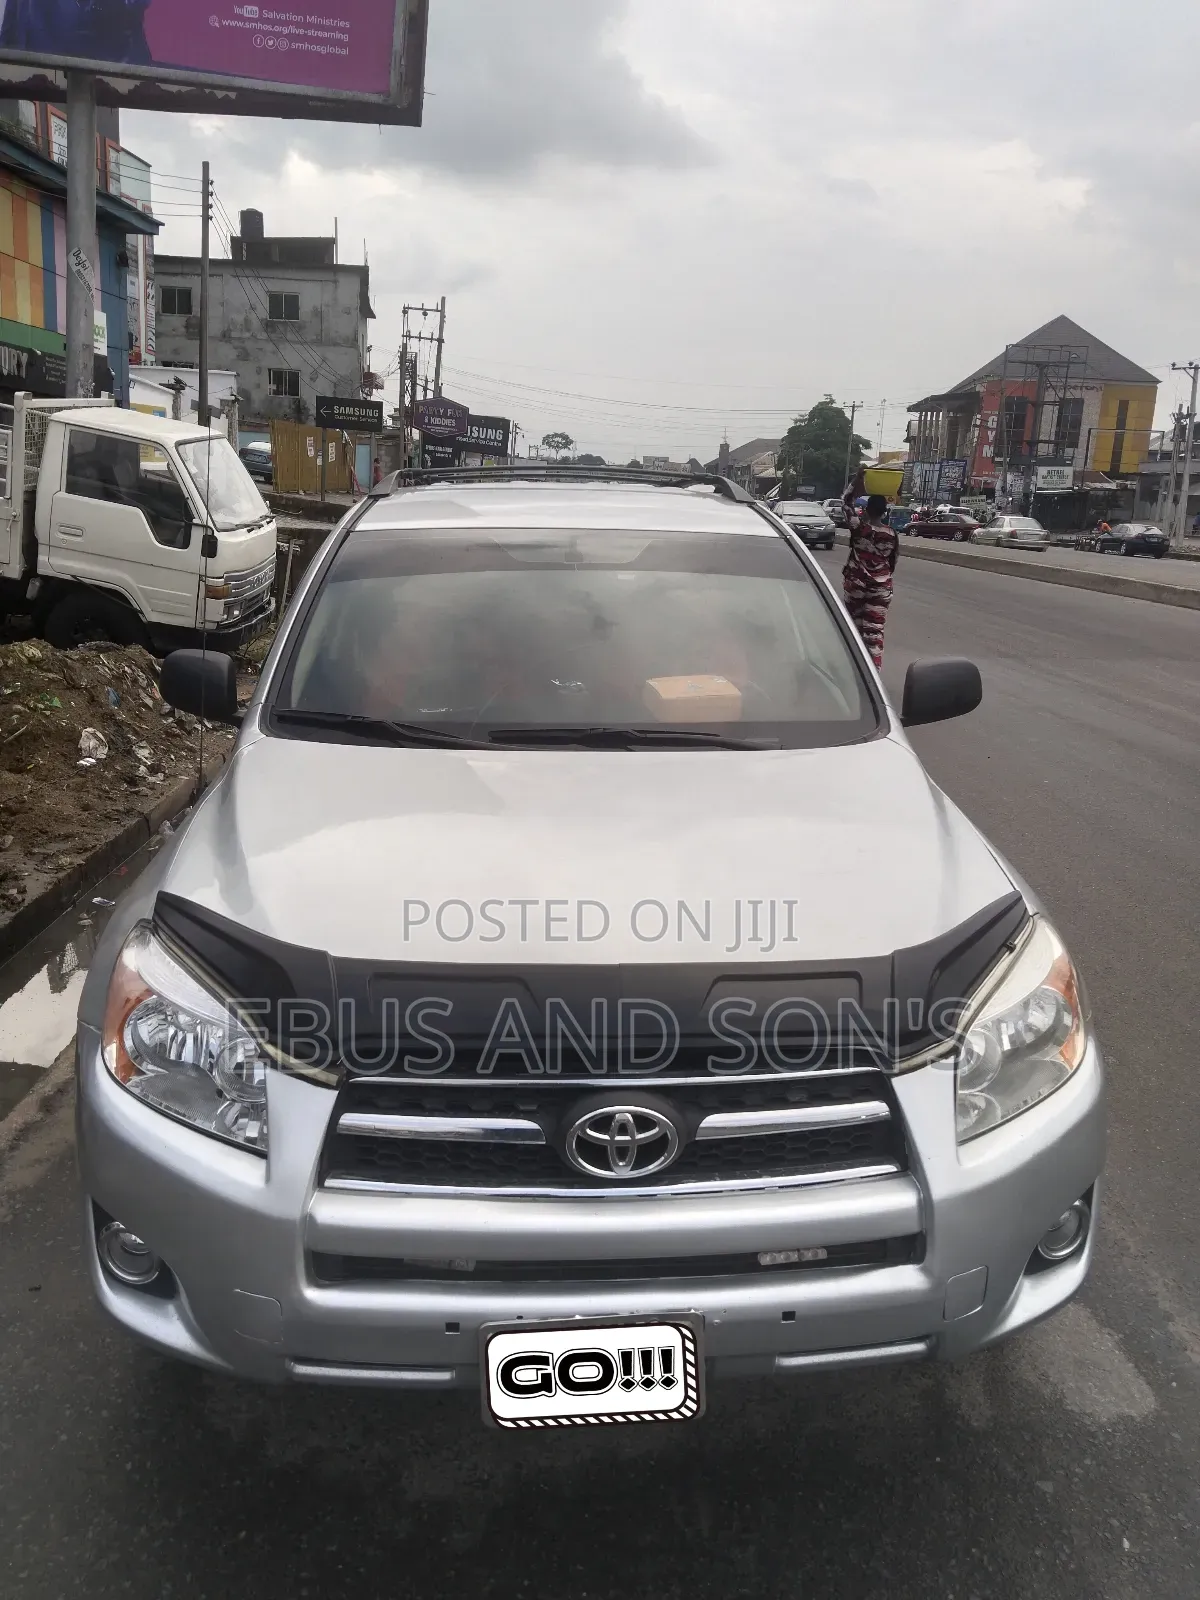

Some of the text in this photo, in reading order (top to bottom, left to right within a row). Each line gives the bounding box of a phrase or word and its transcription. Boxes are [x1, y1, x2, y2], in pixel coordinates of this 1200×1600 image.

[234, 5, 350, 28] YouTube Salvation Ministries
[221, 18, 349, 42] www.smhos.org/live-streaming
[290, 41, 349, 55] smhosglobal
[333, 405, 379, 417] SAMSUNG
[430, 416, 456, 427] KIDDIES
